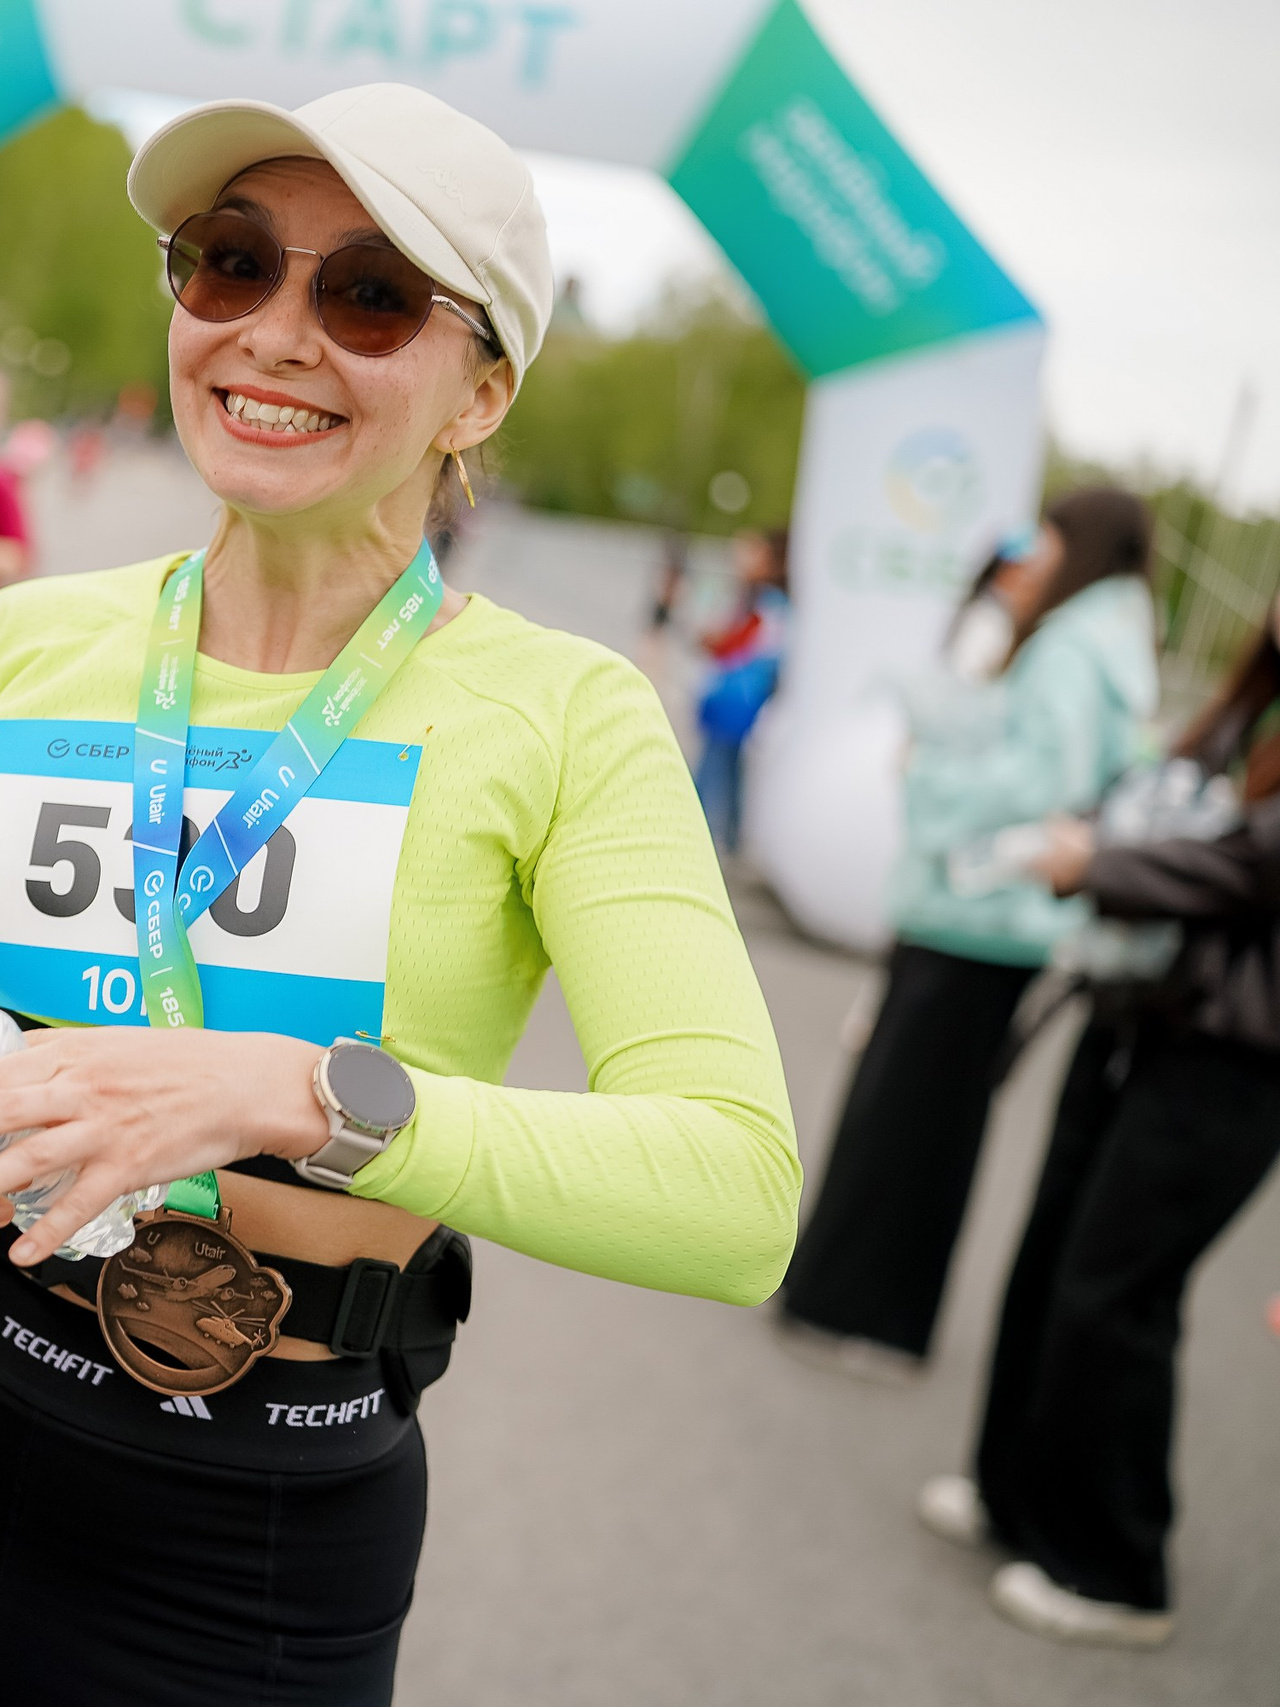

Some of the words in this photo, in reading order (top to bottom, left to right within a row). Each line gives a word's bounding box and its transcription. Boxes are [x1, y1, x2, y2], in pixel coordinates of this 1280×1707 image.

[399, 593, 424, 622] 185
[376, 618, 401, 650] лет
[75, 743, 130, 759] СБЕР
[149, 784, 167, 825] Utair
[242, 788, 280, 830] Utair
[147, 900, 164, 960] СБЕР
[159, 986, 186, 1028] 185
[82, 965, 148, 1017] 10
[194, 1241, 227, 1260] Utair
[1, 1315, 114, 1386] TECHFIT
[266, 1388, 385, 1427] TECHFIT
